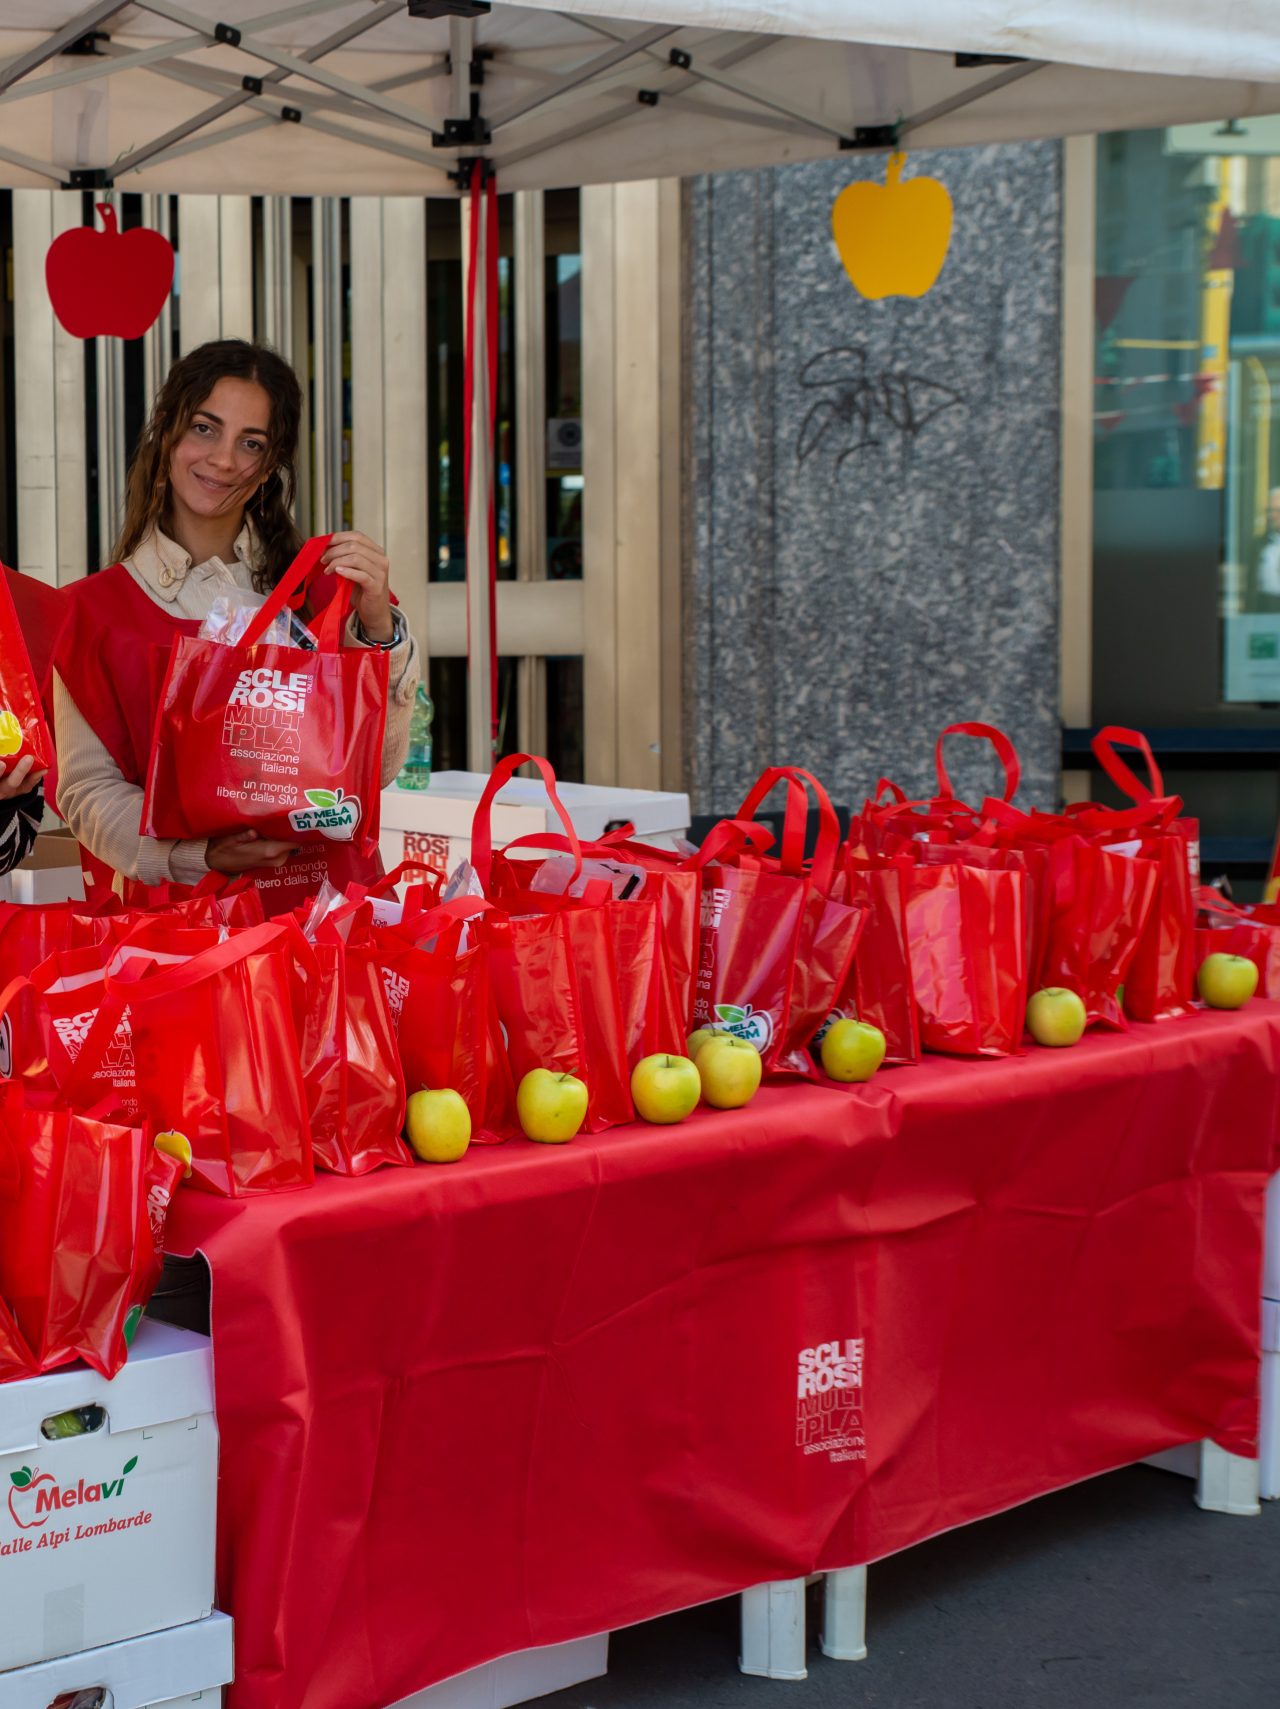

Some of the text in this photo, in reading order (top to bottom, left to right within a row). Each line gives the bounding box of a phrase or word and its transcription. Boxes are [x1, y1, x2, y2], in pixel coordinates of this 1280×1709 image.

[236, 667, 308, 693] SCLE
[224, 705, 305, 731] MULT
[230, 748, 300, 764] associazione
[261, 762, 299, 775] italiana
[216, 786, 297, 806] libero dalla SM
[243, 780, 298, 795] un mondo
[294, 807, 350, 821] LA MELA
[296, 813, 353, 830] DI AISM
[274, 860, 328, 875] un mondo
[254, 870, 329, 889] libero dalla SM
[381, 967, 408, 994] CLE
[92, 1068, 136, 1080] ssociazione
[798, 1338, 864, 1374] SCLE
[36, 1527, 71, 1549] Alpi
[74, 1510, 153, 1540] Lombarde
